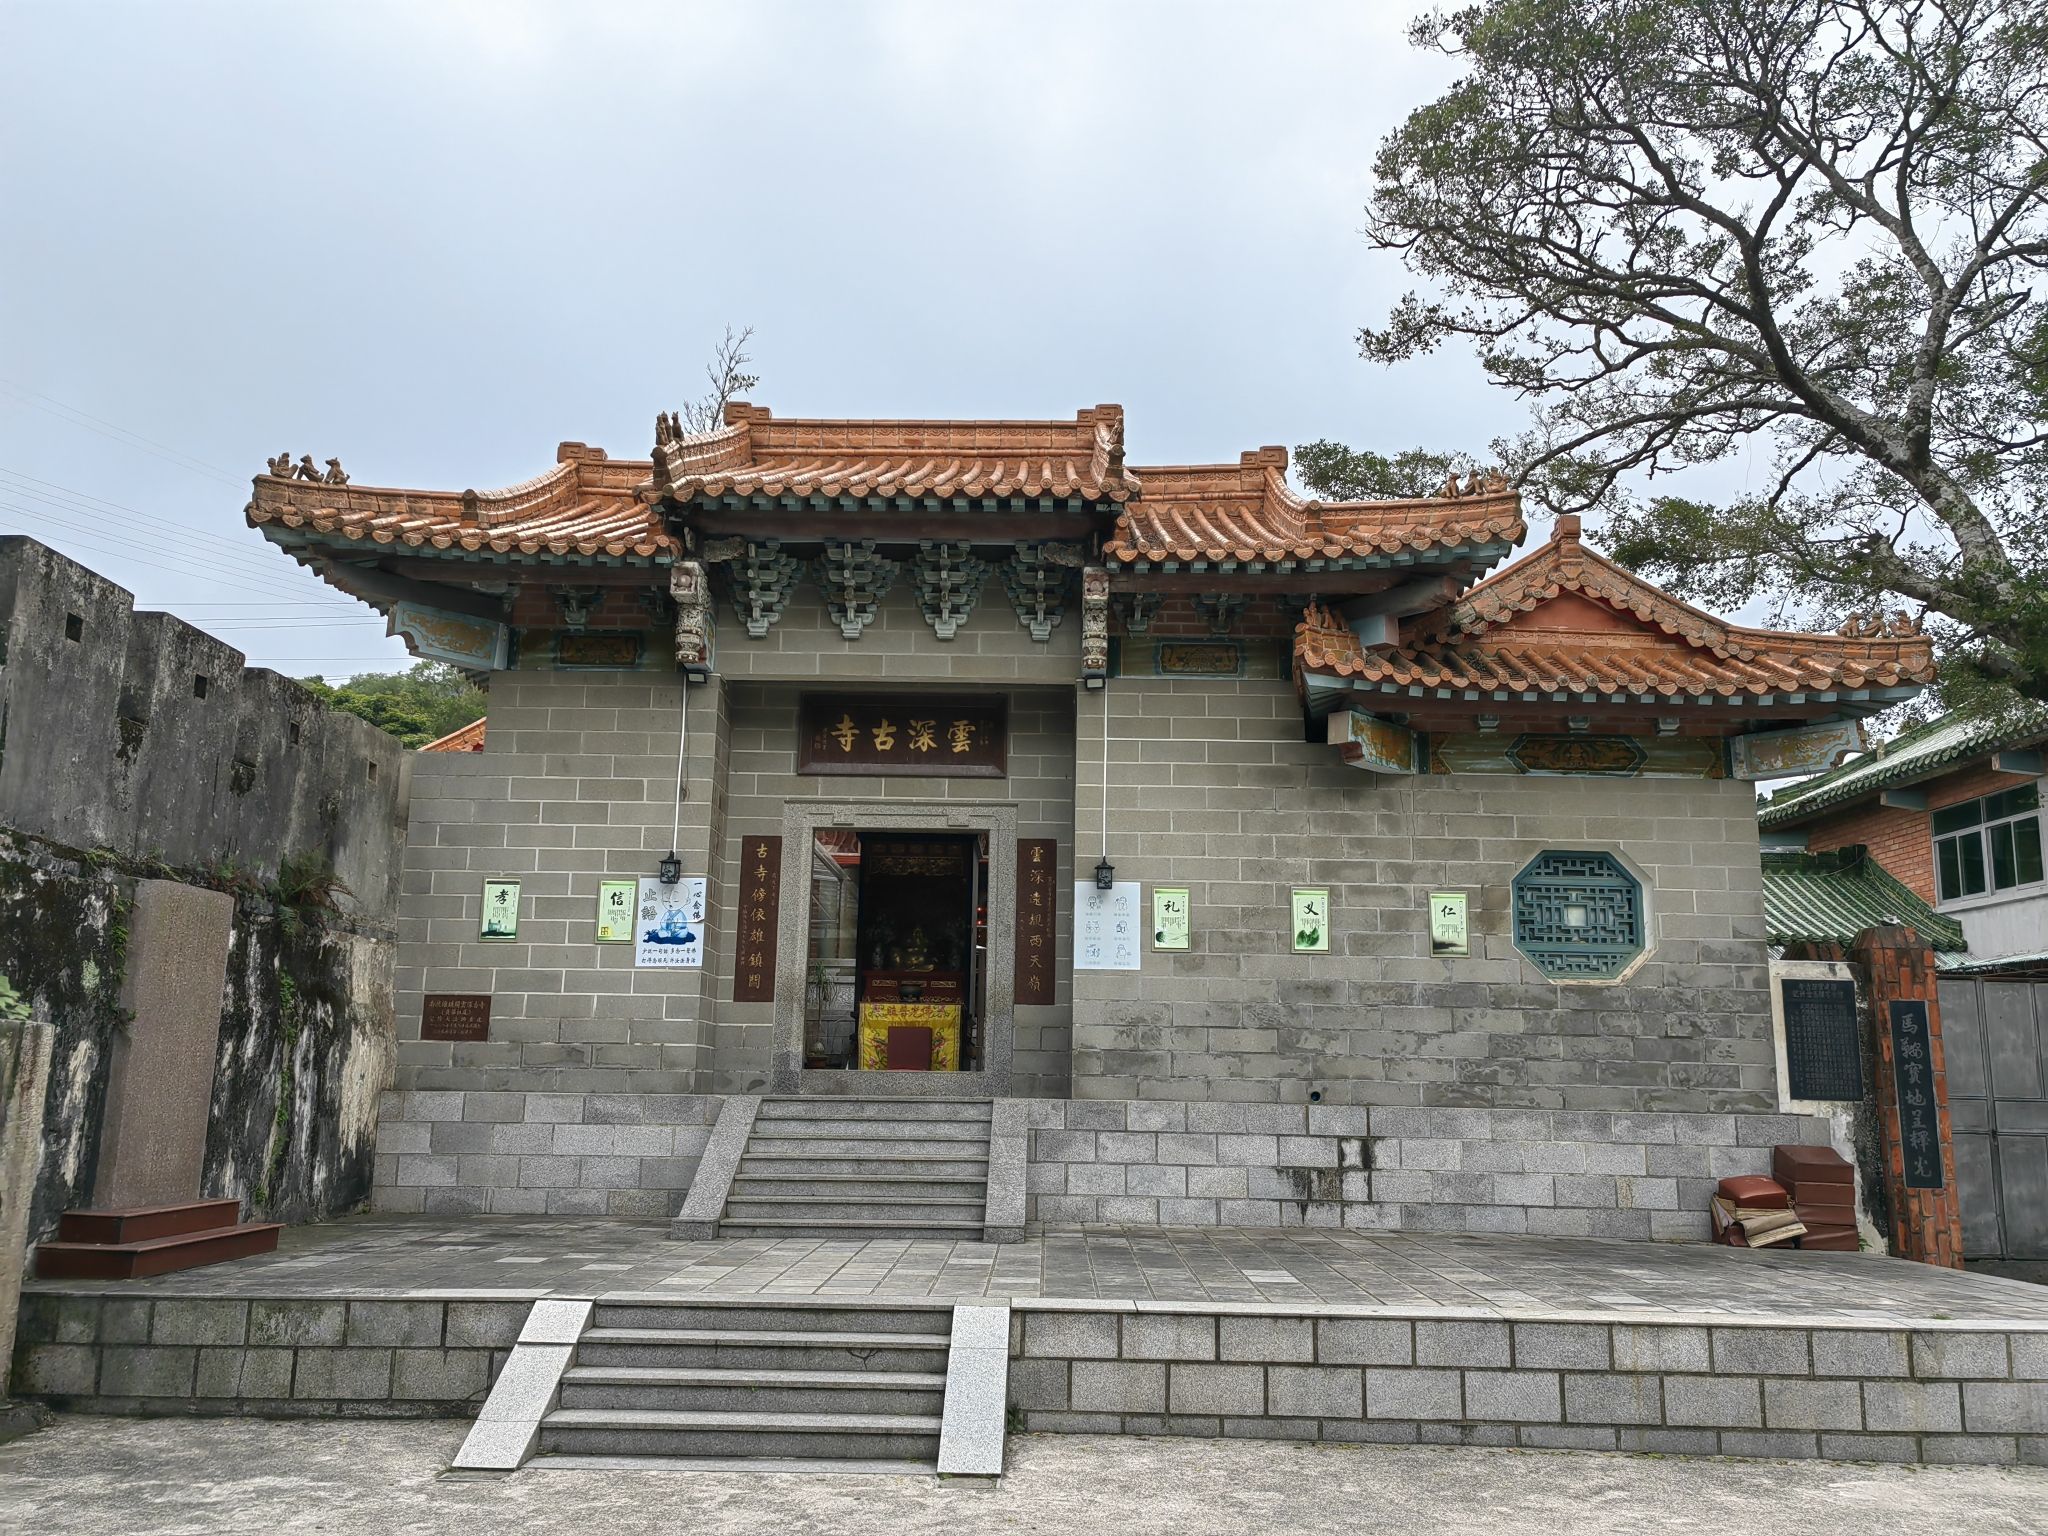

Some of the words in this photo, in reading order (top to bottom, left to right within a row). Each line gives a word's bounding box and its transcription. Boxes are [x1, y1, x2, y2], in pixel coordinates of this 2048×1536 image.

[830, 714, 976, 753] 雲深古寺
[494, 888, 509, 905] 孝
[610, 891, 624, 906] 信
[641, 888, 658, 921] 止語
[692, 881, 703, 919] 一心念佛
[1163, 900, 1180, 913] 礼
[1303, 900, 1319, 916] 义
[1440, 904, 1456, 918] 仁
